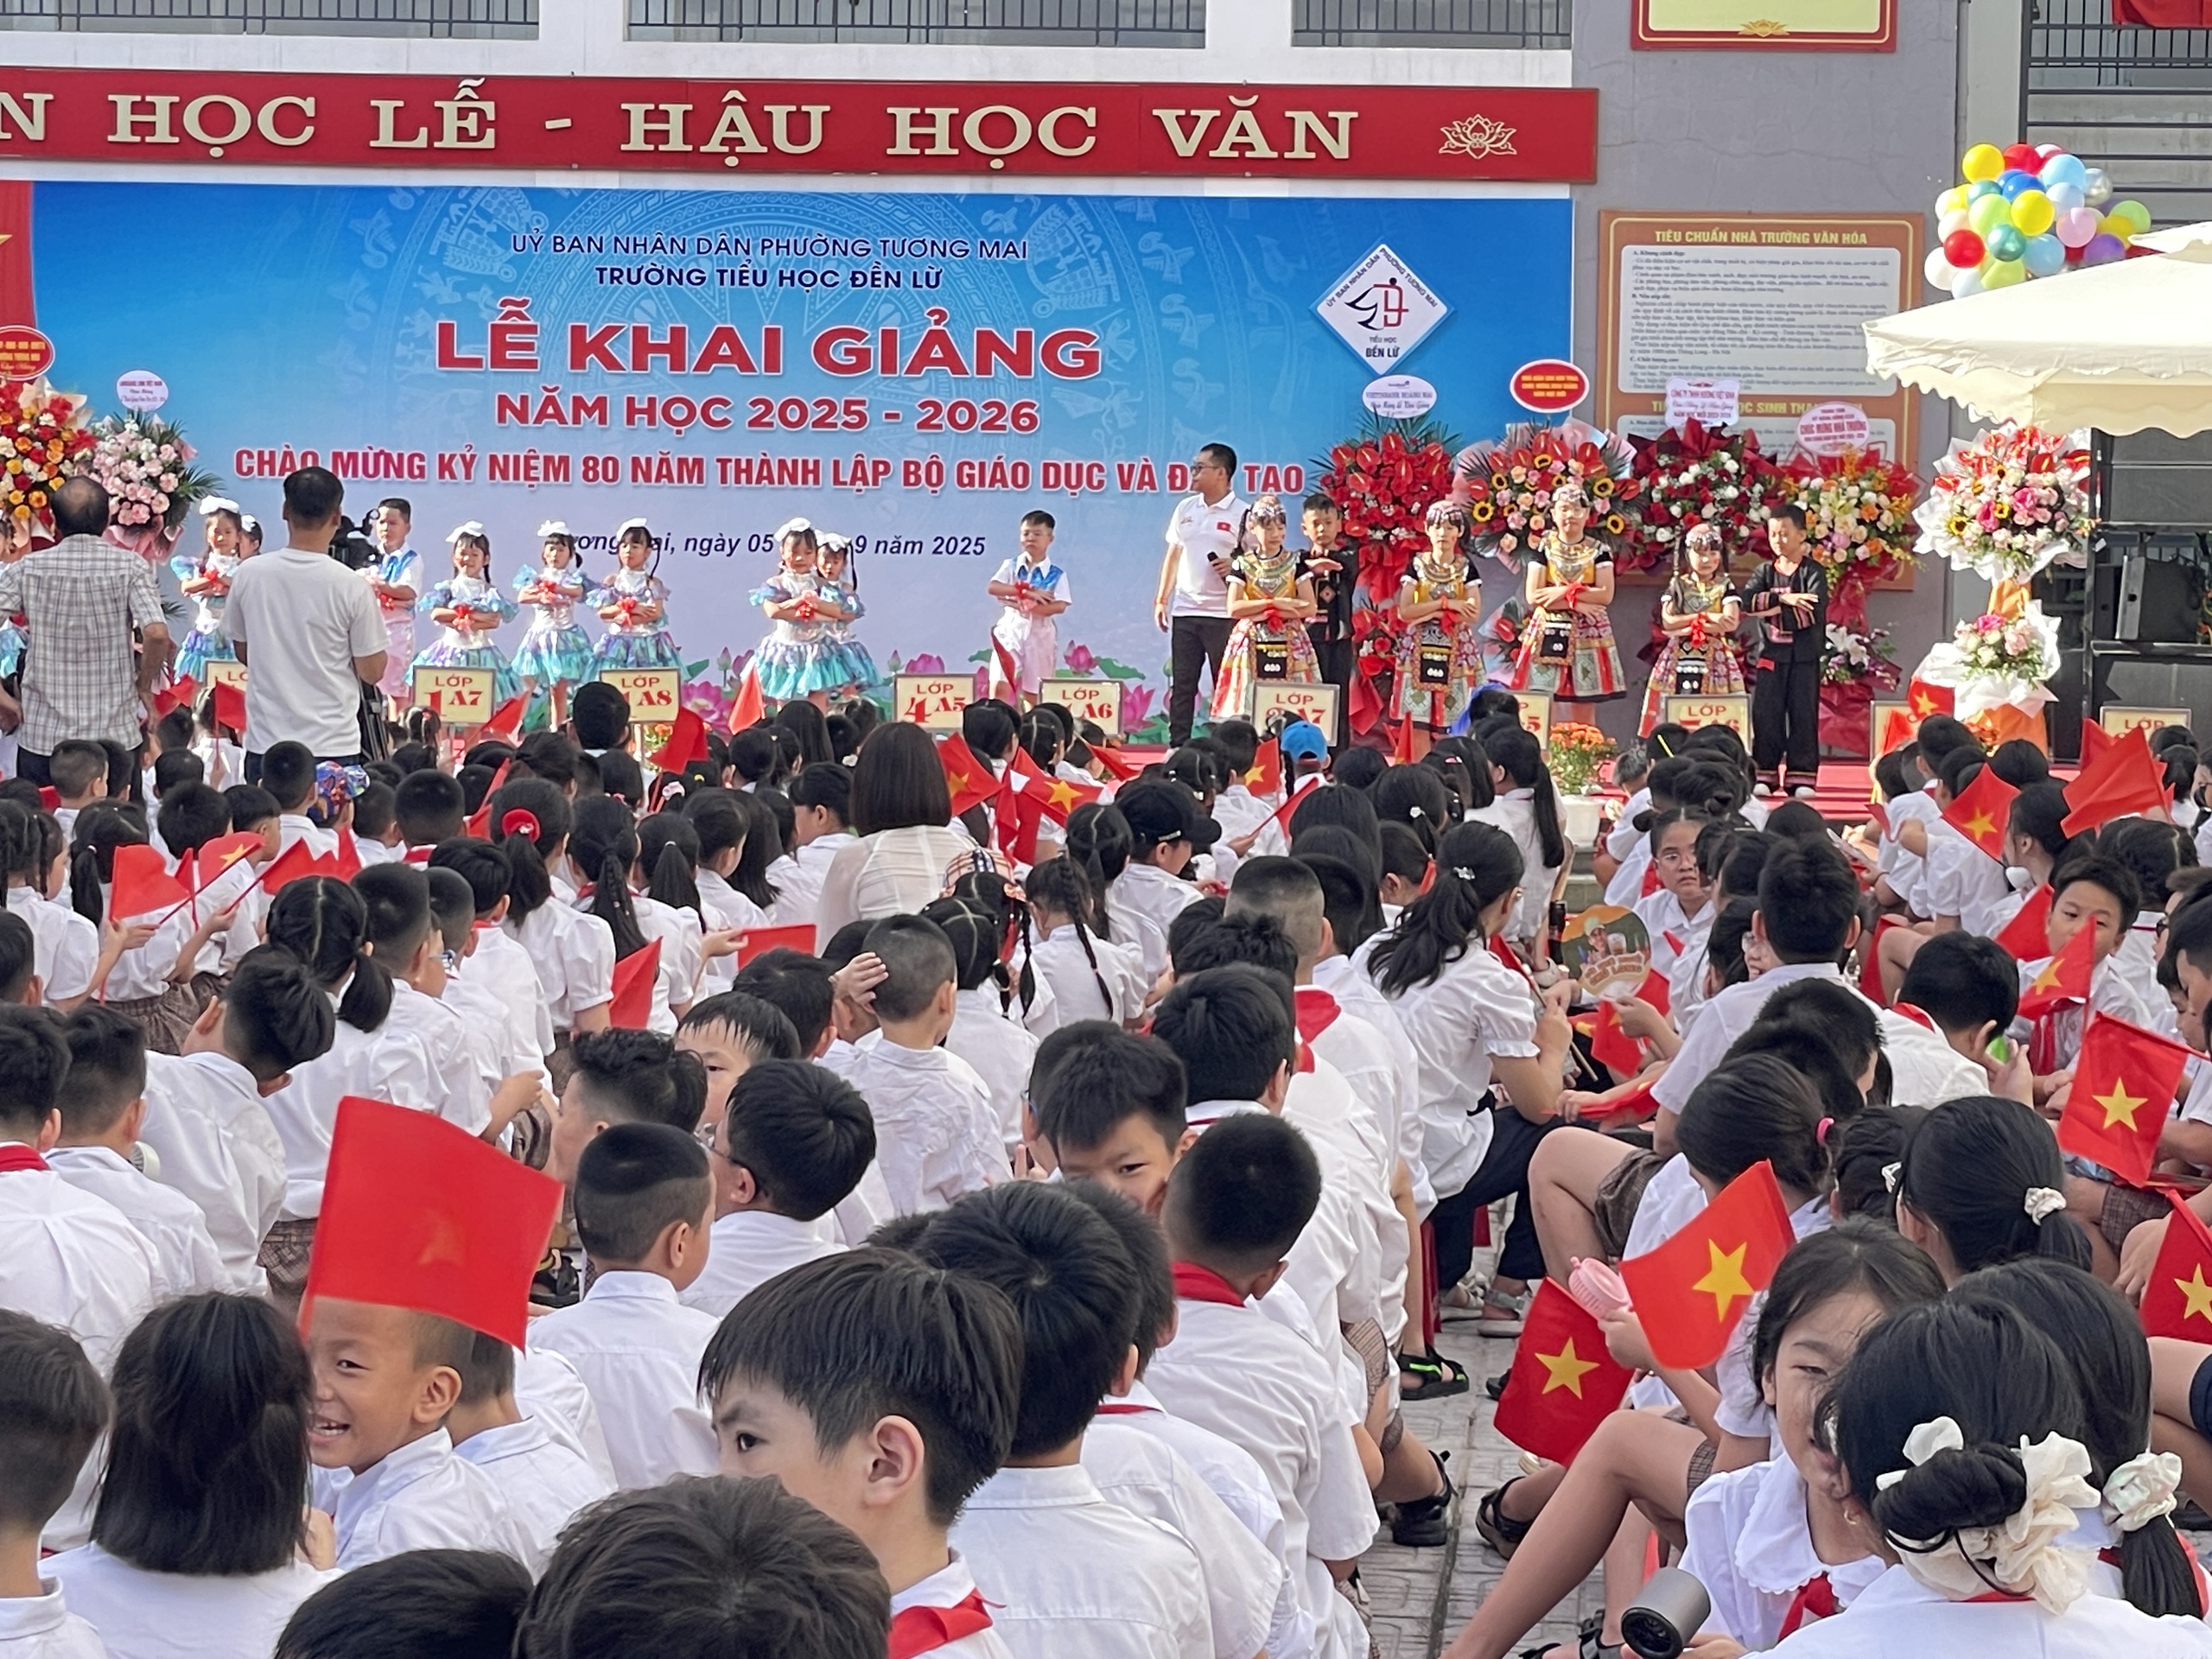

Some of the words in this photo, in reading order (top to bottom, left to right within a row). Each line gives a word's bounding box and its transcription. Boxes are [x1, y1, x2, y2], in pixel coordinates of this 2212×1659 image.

[108, 94, 315, 157] HỌC
[369, 77, 496, 149] LỄ
[545, 118, 571, 130] -
[620, 90, 830, 167] HẬU
[887, 105, 1096, 169] HỌC
[1153, 94, 1358, 160] VĂN
[512, 227, 543, 253] UỶ
[553, 235, 602, 254] BAN
[613, 232, 686, 256] NHÂN
[696, 232, 752, 257] DÂN
[760, 232, 871, 259] PHƯỜNG
[880, 238, 970, 259] TƯƠNG
[978, 240, 1027, 259] MAI
[1655, 230, 1682, 243] TIÊU
[1685, 227, 1728, 243] CHUẨN
[1731, 230, 1758, 243] NHÀ
[1761, 230, 1809, 244] TRƯỜNG
[1814, 231, 1839, 244] VĂN
[595, 262, 707, 287] TRƯỜNG
[716, 258, 767, 288] TIỂU
[779, 270, 840, 294] HỌC
[849, 261, 901, 289] ĐỀN
[912, 265, 944, 289] LỪ
[437, 298, 538, 370] LỄ
[570, 324, 781, 374] KHAI
[812, 308, 1099, 378] GIẢNG
[497, 387, 607, 425] NĂM
[626, 396, 732, 435] HỌC
[747, 397, 868, 429] 2025
[885, 412, 900, 422] -
[917, 399, 1039, 432] 2026
[235, 444, 320, 477] CHÀO
[332, 445, 426, 480] MỪNG
[438, 443, 478, 481] KỶ
[488, 449, 570, 489] NIỆM
[581, 455, 620, 484] 80
[630, 450, 705, 485] NĂM
[716, 451, 821, 486] THÀNH
[831, 453, 893, 493] LẬP
[903, 454, 945, 494] BỘ
[956, 454, 1032, 490] GIÁO
[1041, 461, 1106, 496] DỤC
[1117, 457, 1159, 492] VÀ
[683, 532, 741, 558] ngày
[747, 534, 774, 553] 05
[874, 535, 924, 555] năm
[931, 536, 986, 556] 2025
[435, 673, 473, 687] LỚP
[621, 675, 660, 688] LỚP
[917, 681, 954, 695] LỚP
[1062, 687, 1100, 700] LỚP
[1275, 691, 1314, 705] LỚP
[1688, 702, 1726, 716] LỚP
